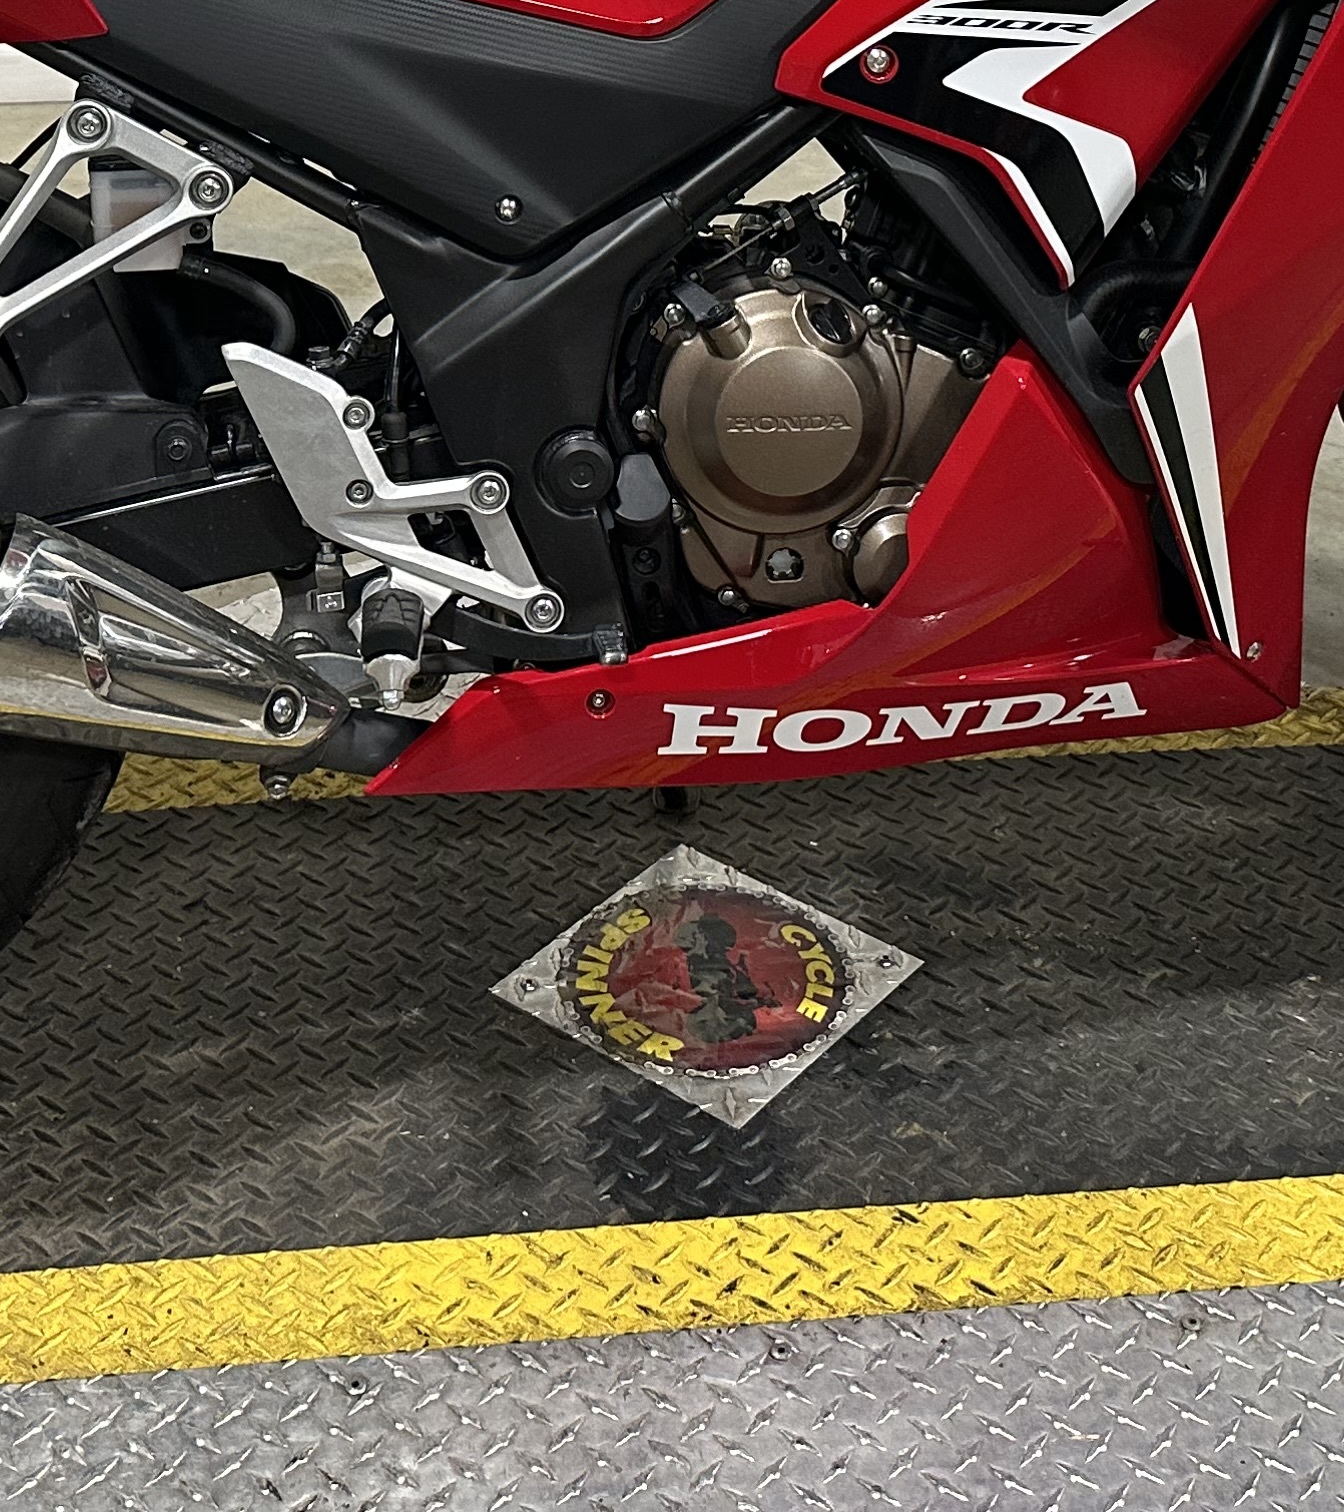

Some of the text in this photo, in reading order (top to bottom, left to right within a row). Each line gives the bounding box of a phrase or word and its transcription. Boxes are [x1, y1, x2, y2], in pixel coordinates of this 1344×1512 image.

[906, 14, 1096, 35] 300R
[726, 415, 852, 433] HONDA
[657, 681, 1147, 755] HONDA
[575, 908, 834, 1062] CYCLE SPINNER
